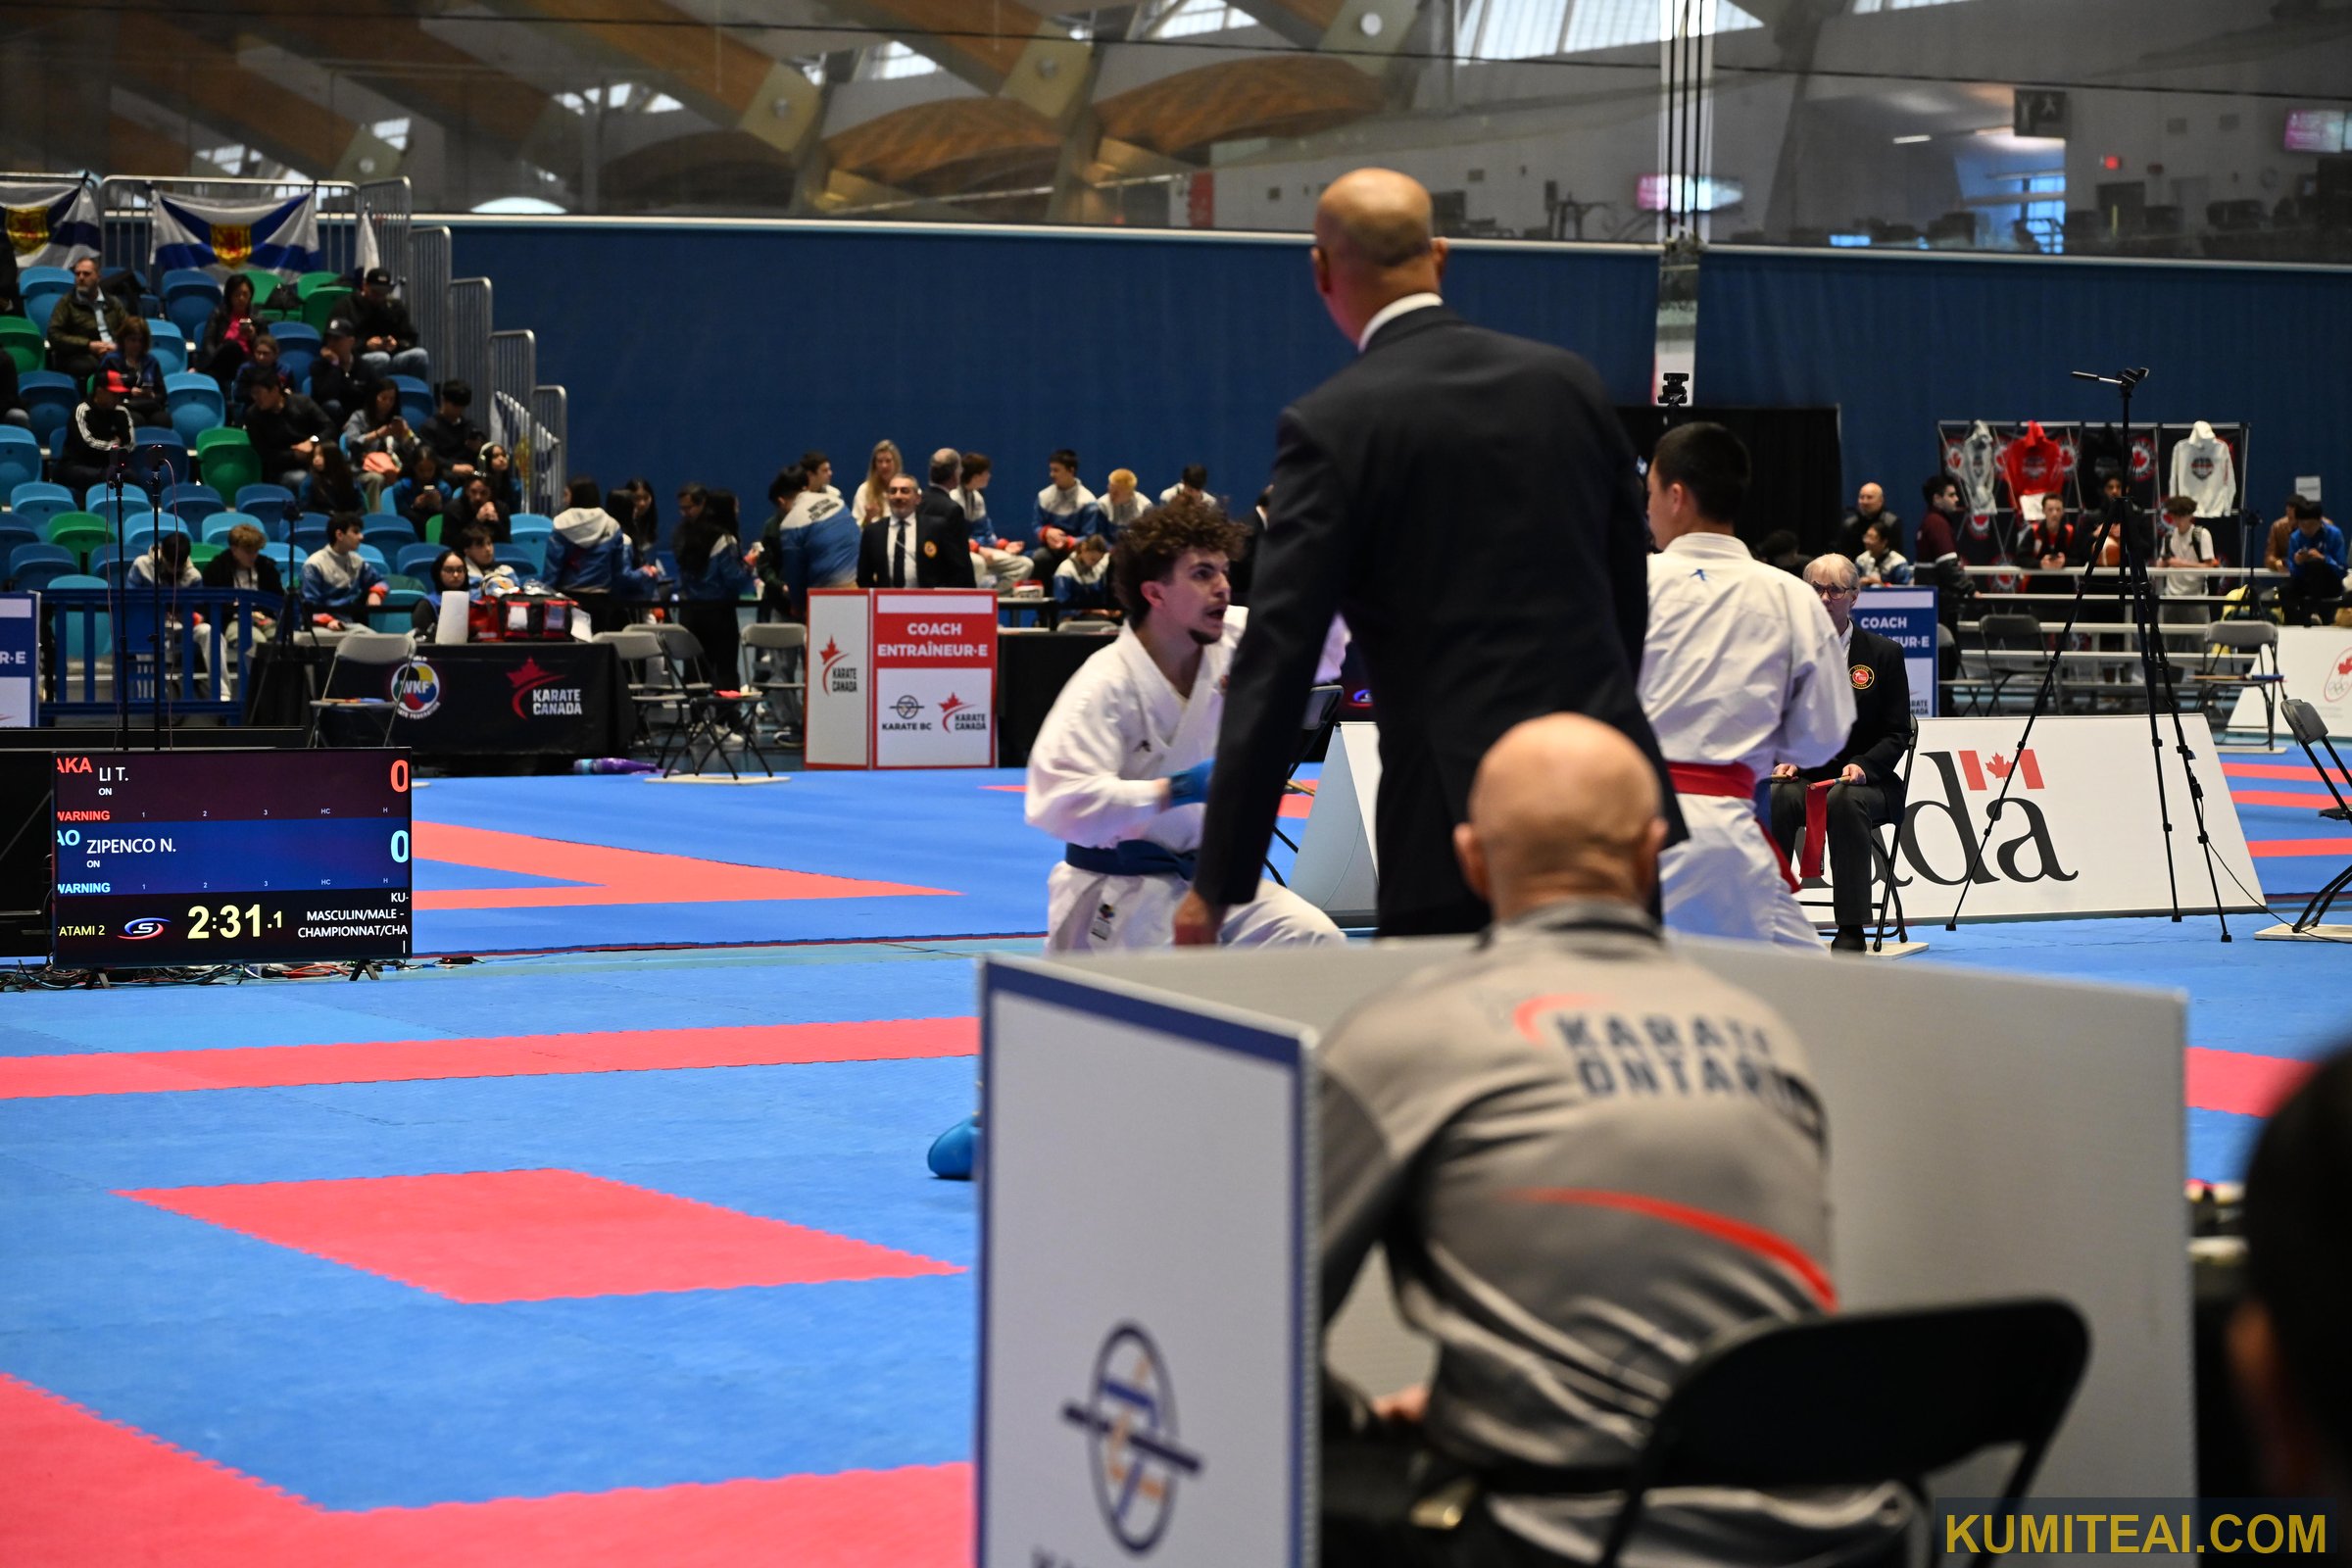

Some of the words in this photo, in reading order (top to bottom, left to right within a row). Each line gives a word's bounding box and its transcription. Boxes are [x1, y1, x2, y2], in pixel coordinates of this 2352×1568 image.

[906, 622, 962, 636] COACH
[1860, 616, 1908, 629] COACH
[832, 667, 858, 679] KARATE
[399, 679, 431, 694] WKF
[832, 681, 858, 692] CANADA
[532, 688, 581, 702] KARATE
[532, 702, 582, 715] CANADA
[955, 713, 986, 722] KARATE
[955, 721, 987, 731] CANADA
[99, 766, 111, 781] LI
[116, 766, 128, 781] T.
[391, 760, 409, 793] 0
[98, 787, 113, 796] ON
[86, 838, 156, 855] ZIPENCO
[160, 838, 176, 853] N.
[391, 830, 409, 863] 0
[86, 859, 100, 868] ON
[307, 908, 397, 921] MASCULIN/MALE
[58, 925, 95, 937] ATAMI
[98, 924, 106, 936] 2
[297, 925, 408, 938] CHAMPIONNAT/CHA
